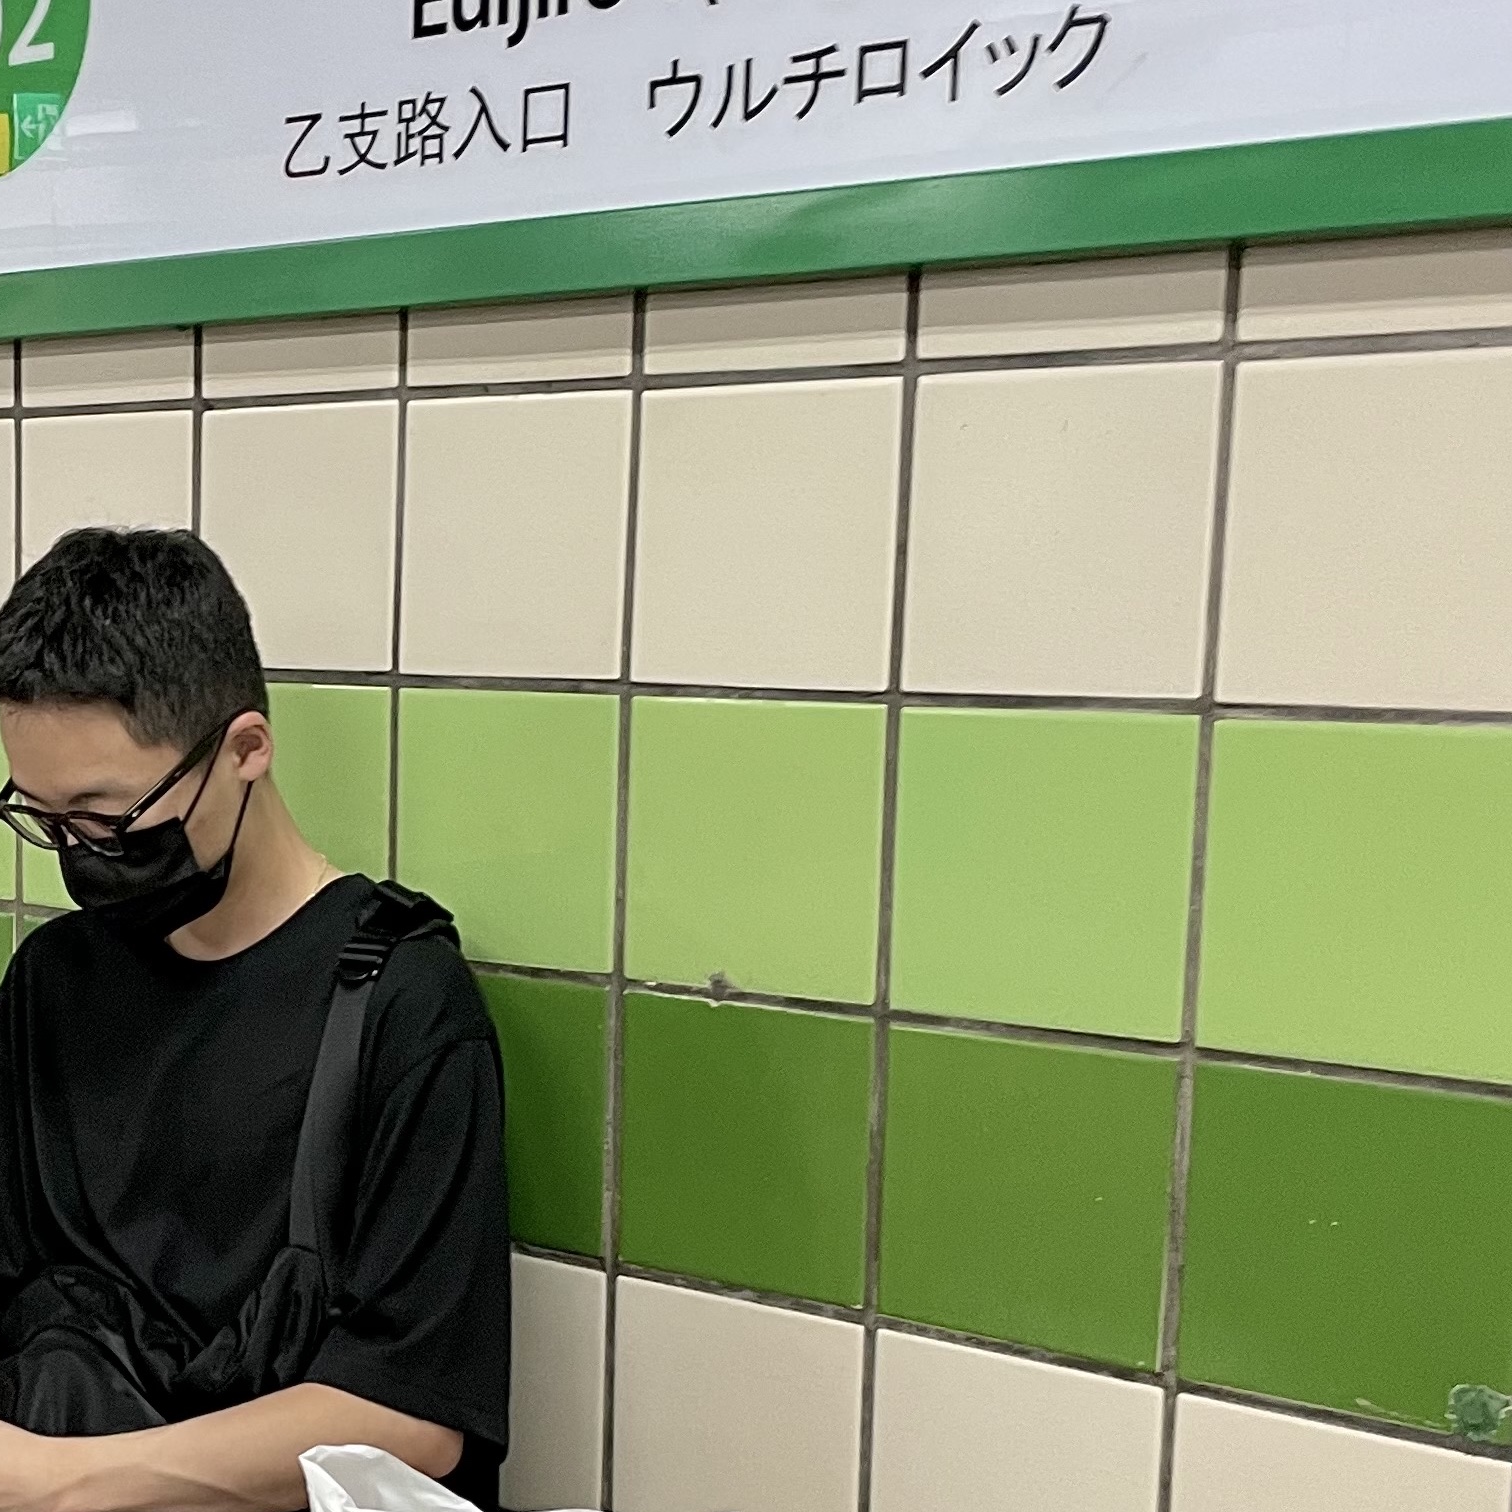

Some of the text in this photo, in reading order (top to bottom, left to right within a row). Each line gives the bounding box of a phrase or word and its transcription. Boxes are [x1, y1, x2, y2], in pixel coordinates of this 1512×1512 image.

[284, 82, 571, 178] 乙支路入口
[647, 4, 1108, 138] ウルチロイック
